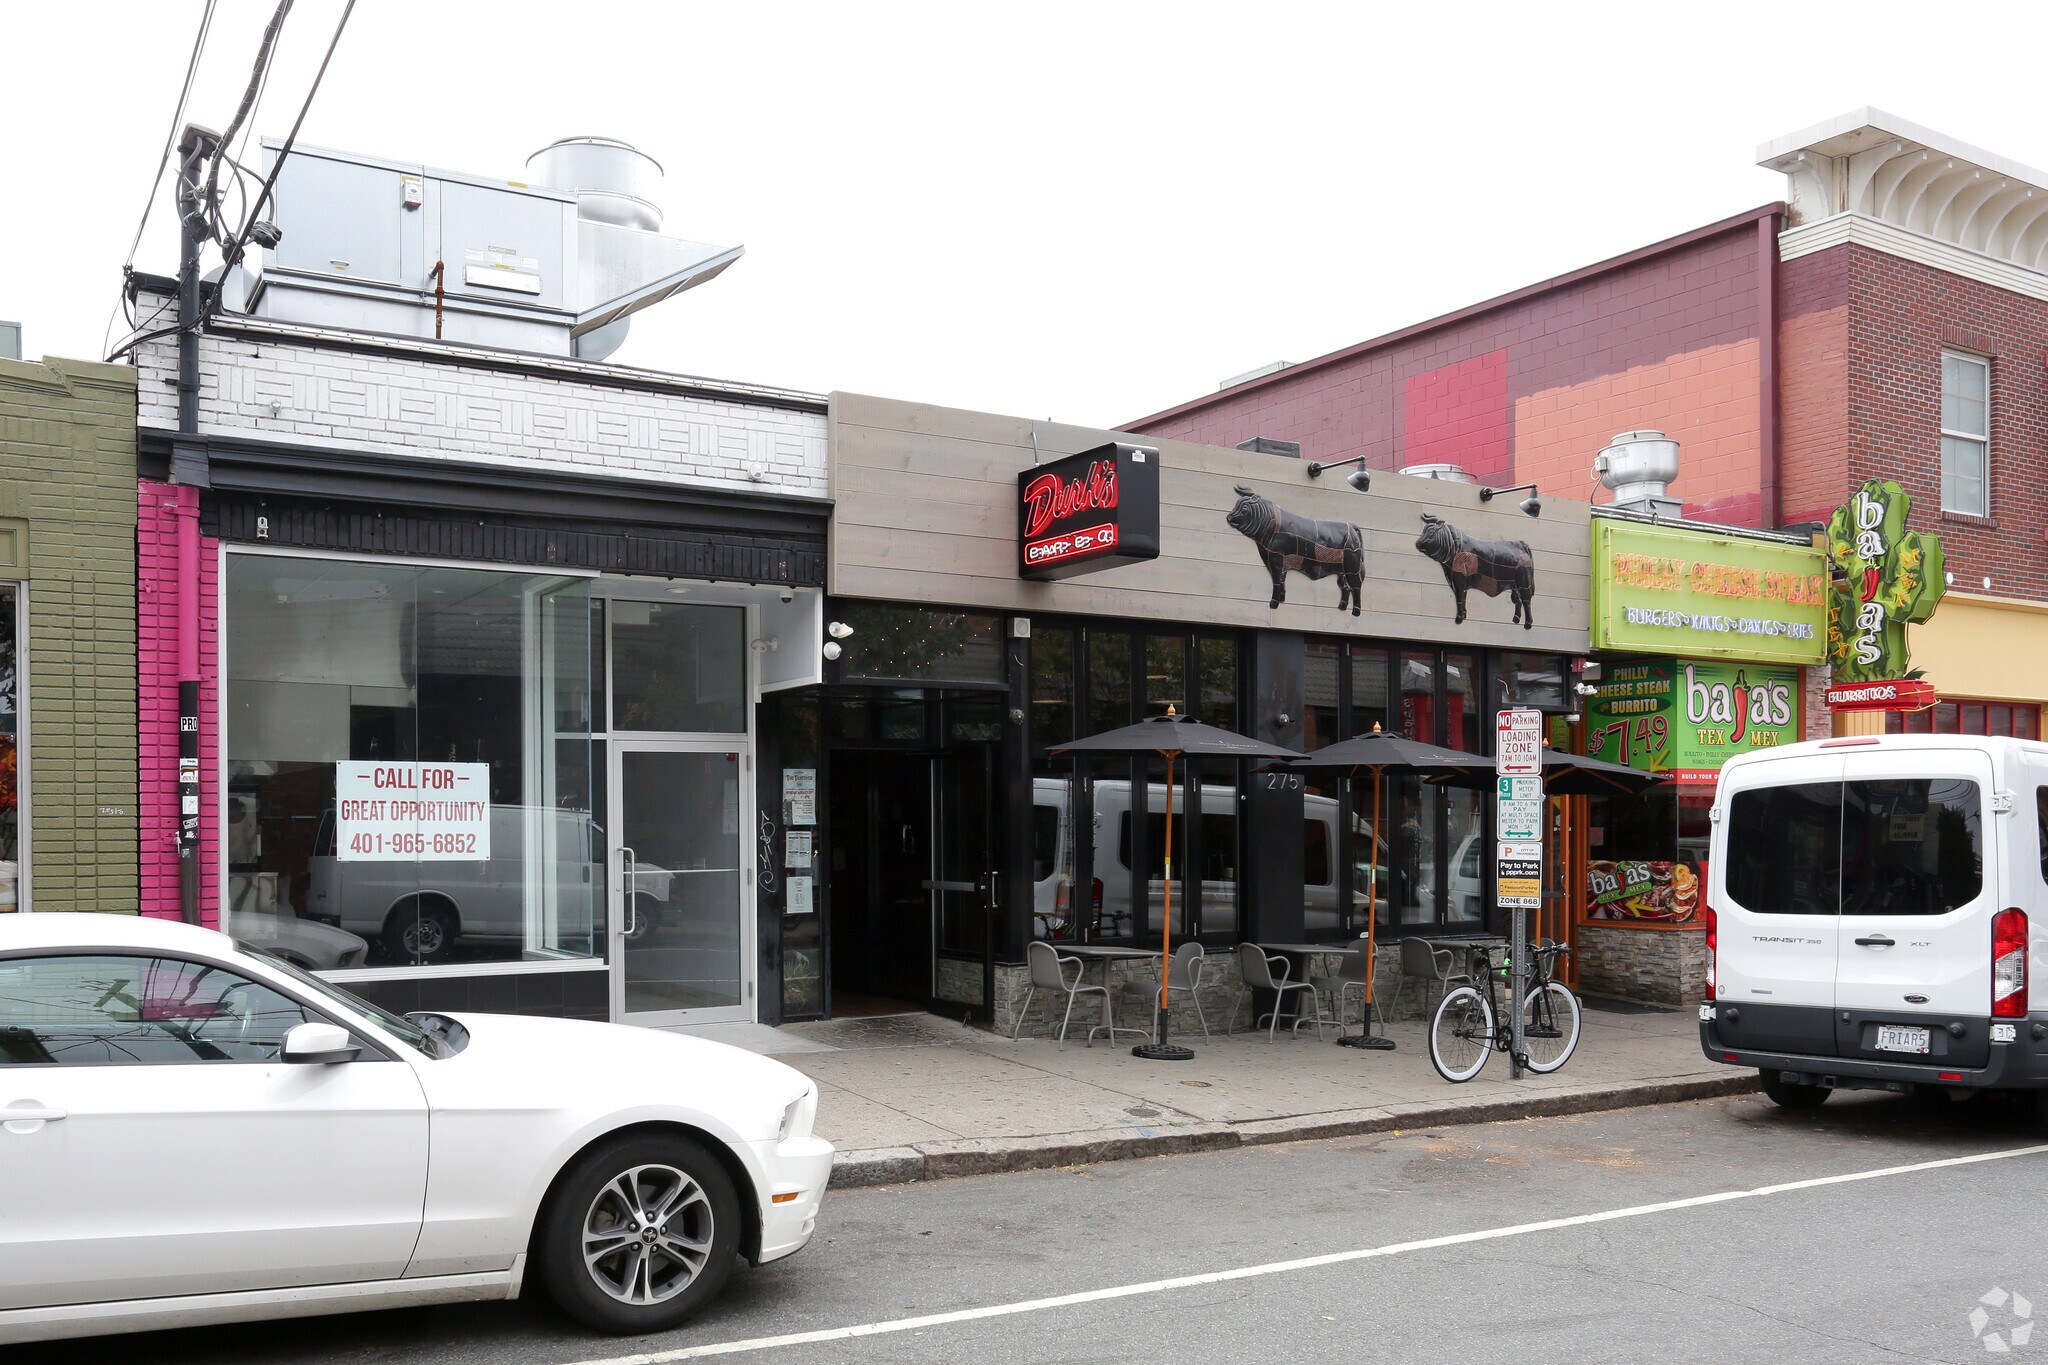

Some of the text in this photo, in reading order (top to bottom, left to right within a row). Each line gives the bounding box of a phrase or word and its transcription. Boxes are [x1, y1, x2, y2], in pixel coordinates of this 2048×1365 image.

[1615, 552, 1825, 606] PHILLY CHEESE STEAK
[1627, 607, 1682, 628] BURGERS
[1614, 666, 1648, 681] PHILLY
[1636, 680, 1671, 695] STEAK
[1828, 685, 1896, 703] BURRITOS
[1611, 698, 1658, 714] BURRITO
[1684, 663, 1791, 742] baja's
[1499, 714, 1539, 728] NO PARKING
[1502, 731, 1537, 742] LOADING
[1588, 715, 1669, 766] $7.49
[1697, 729, 1779, 746] TEX MEX
[1505, 743, 1533, 753] ZONE
[1501, 754, 1537, 762] 7AM TO 10AM
[374, 768, 454, 789] CALL FOR
[1267, 773, 1298, 789] 275
[1503, 780, 1509, 792] 3
[341, 800, 485, 821] GREAT OPPORTUNITY
[350, 833, 476, 854] 401-965-6852
[1504, 847, 1512, 857] P
[1500, 862, 1513, 870] Pay
[1589, 863, 1651, 896] baja's
[1629, 884, 1646, 894] MEX
[1752, 936, 1805, 944] TRANSIT
